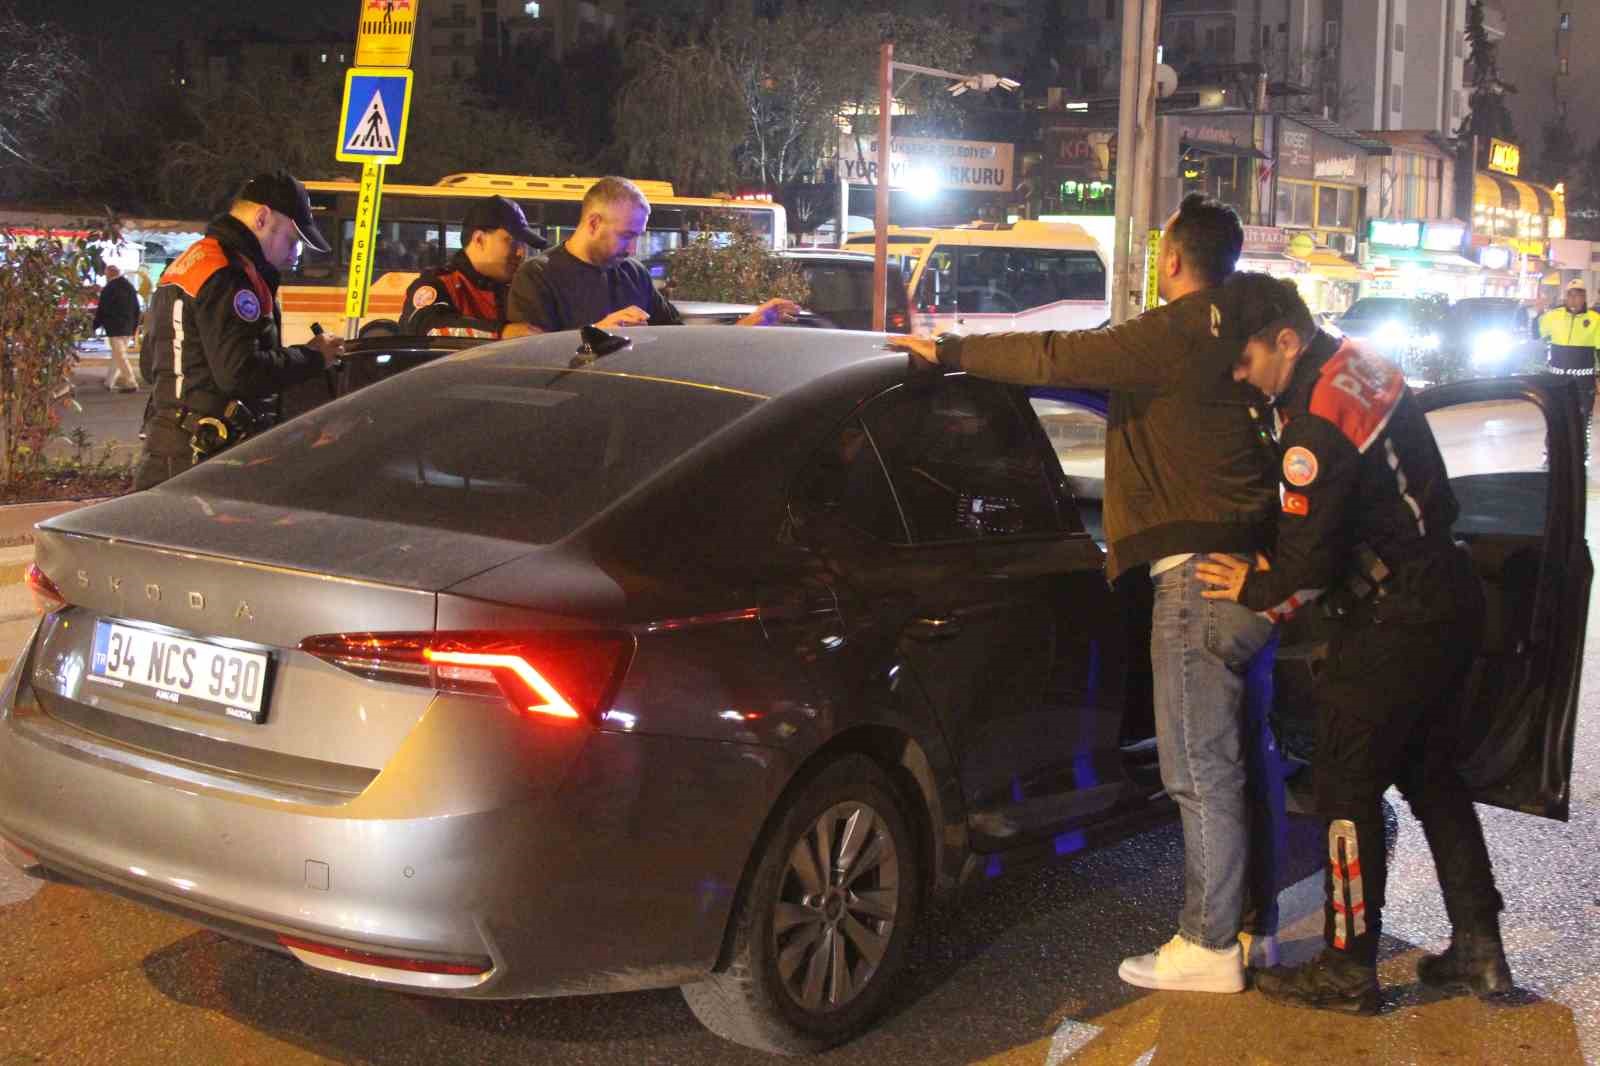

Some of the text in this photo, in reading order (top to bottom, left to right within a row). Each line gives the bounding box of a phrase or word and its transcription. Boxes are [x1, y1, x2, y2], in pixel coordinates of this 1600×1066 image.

[360, 182, 372, 228] YAYA
[96, 652, 106, 665] TR
[108, 632, 260, 703] 34 NCS 930
